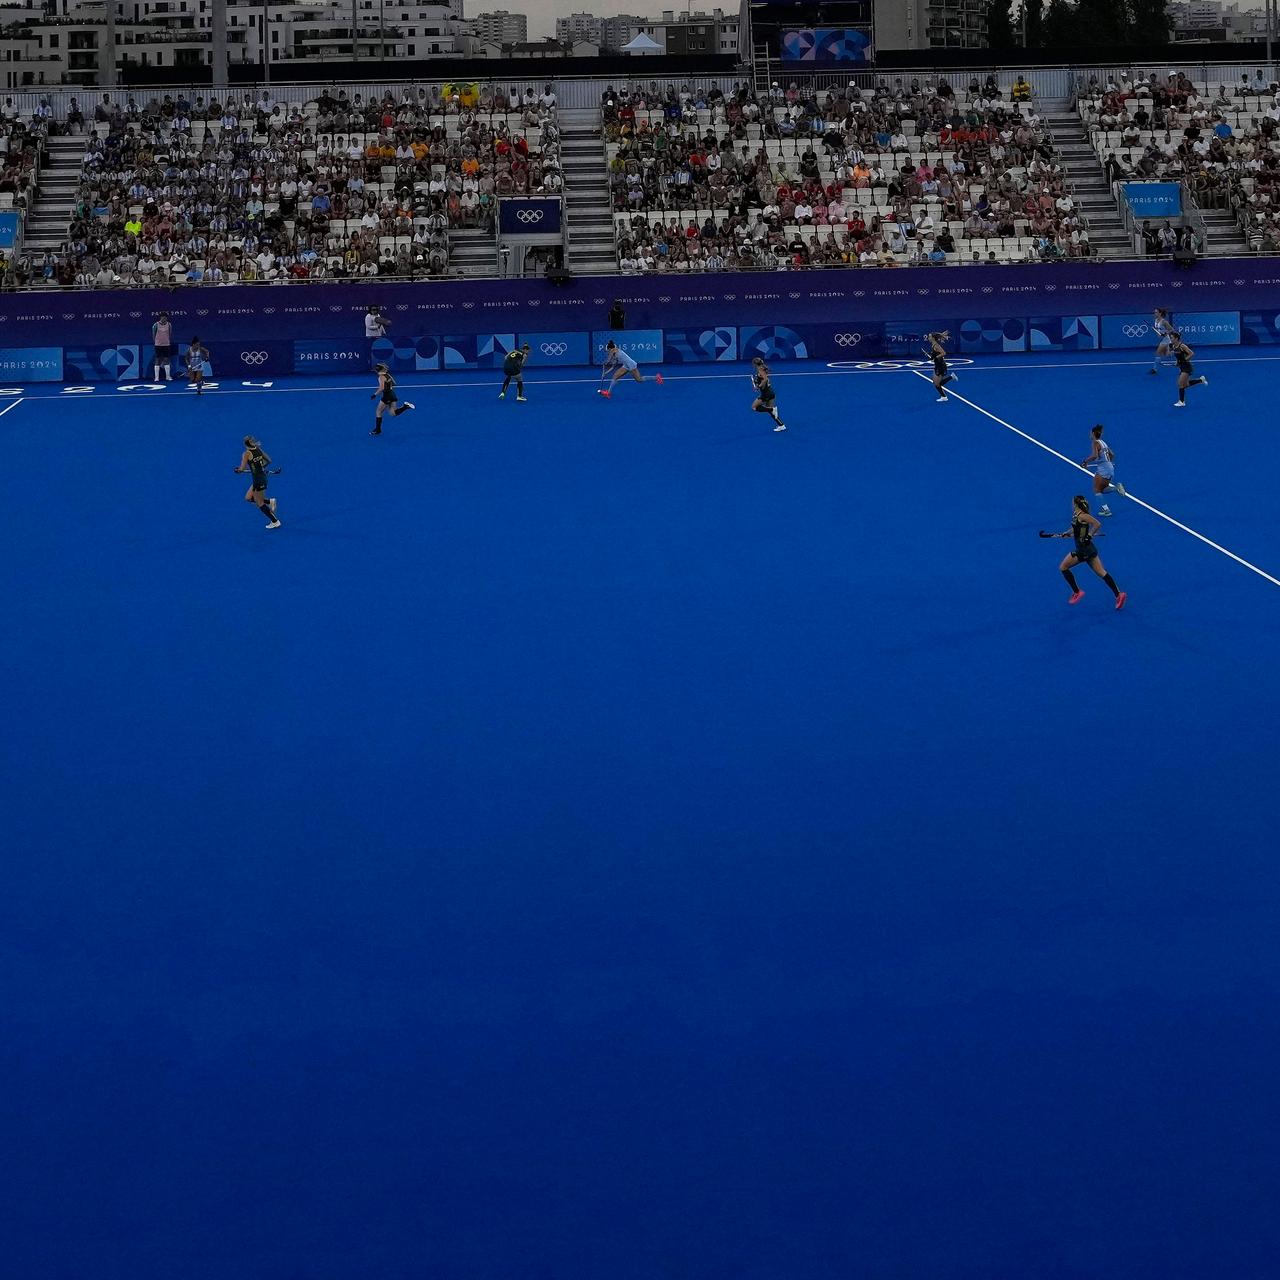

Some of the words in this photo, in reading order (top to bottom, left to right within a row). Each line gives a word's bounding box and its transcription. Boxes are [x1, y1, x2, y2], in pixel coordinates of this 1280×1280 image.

[1177, 325, 1205, 333] PARIS
[1209, 324, 1235, 332] 2024
[300, 352, 330, 361] PARIS
[333, 351, 360, 359] 2024
[29, 360, 57, 368] 2024
